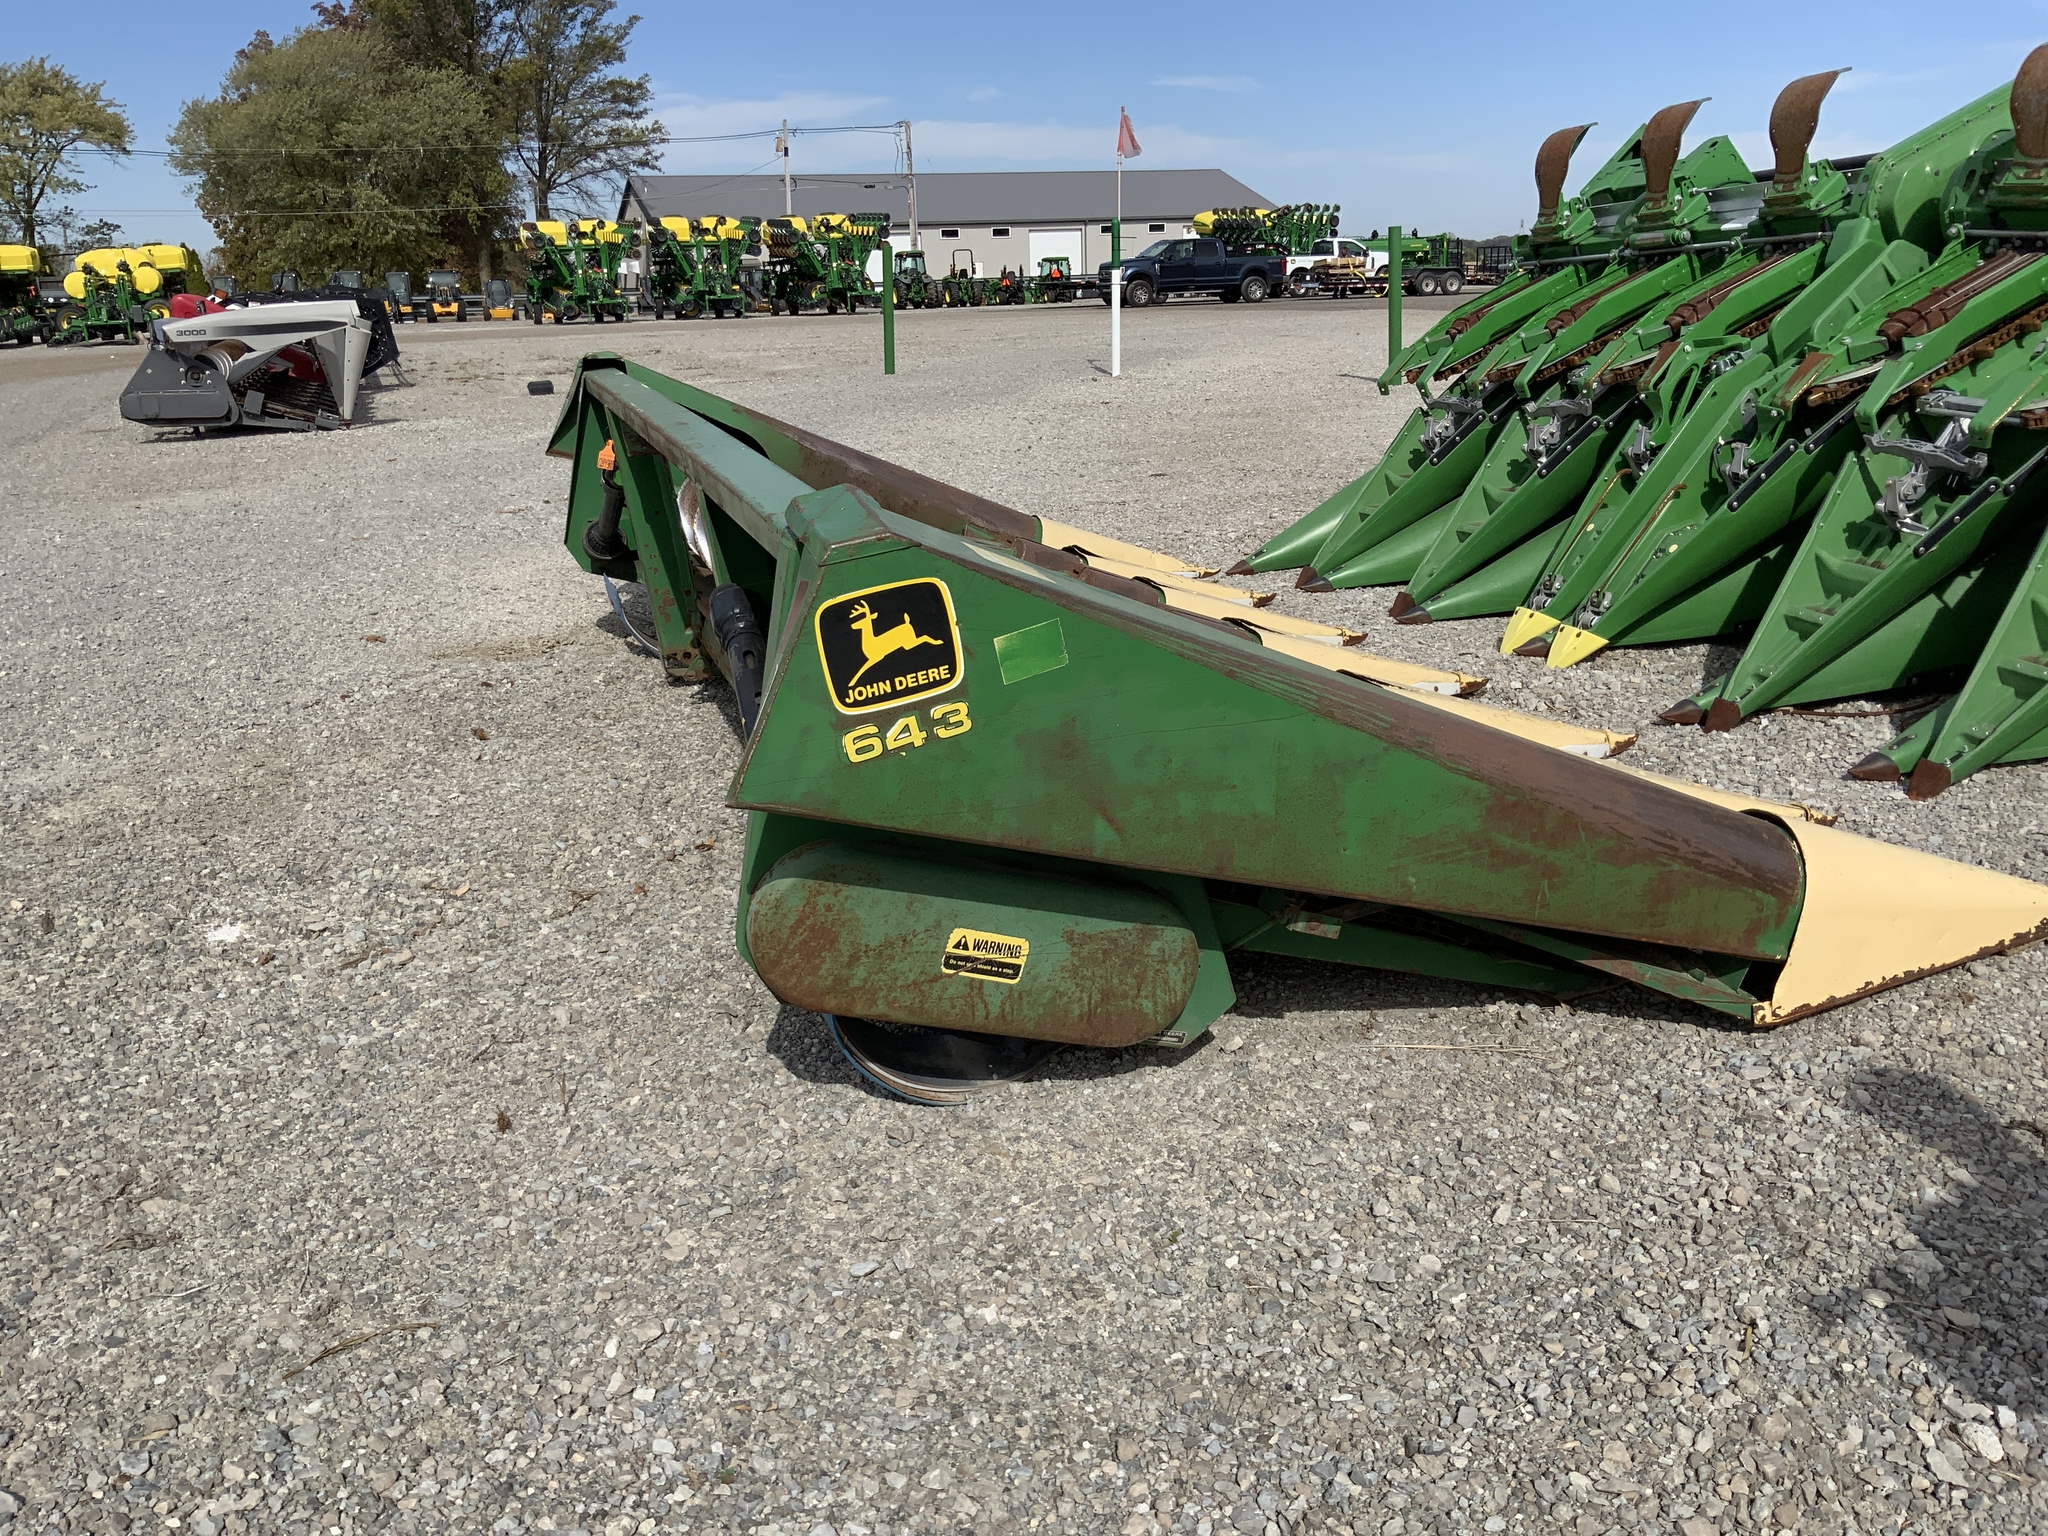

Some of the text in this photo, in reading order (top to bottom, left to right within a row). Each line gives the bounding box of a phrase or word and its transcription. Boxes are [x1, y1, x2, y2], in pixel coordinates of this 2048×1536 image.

[845, 664, 951, 704] JOHN DEERE
[842, 701, 972, 763] 643
[972, 938, 1022, 959] WARNING
